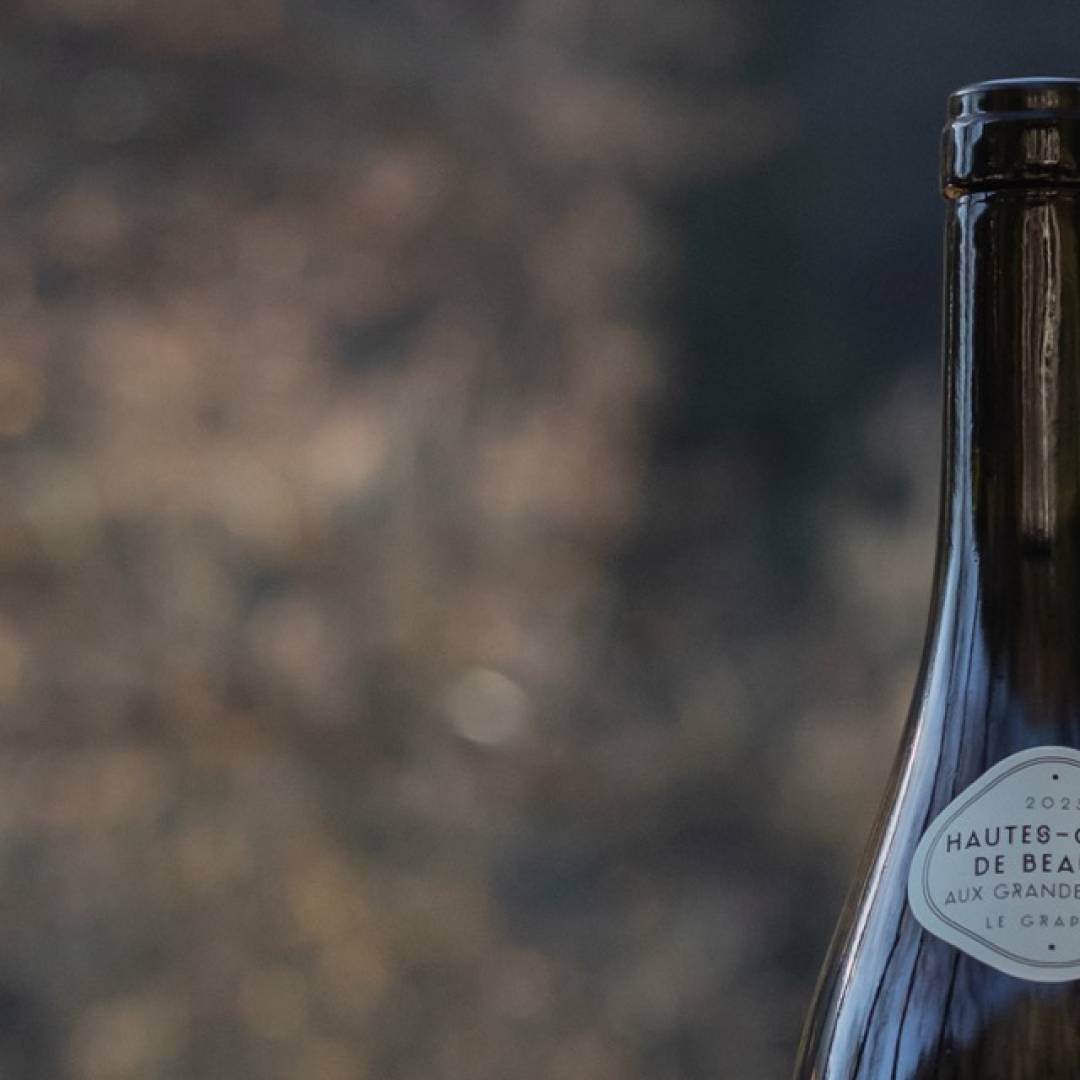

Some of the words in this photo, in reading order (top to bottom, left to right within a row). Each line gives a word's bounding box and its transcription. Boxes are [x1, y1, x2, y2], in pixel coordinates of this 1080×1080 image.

[974, 855, 1005, 876] DE
[944, 886, 983, 905] AUX
[985, 915, 1005, 929] LE
